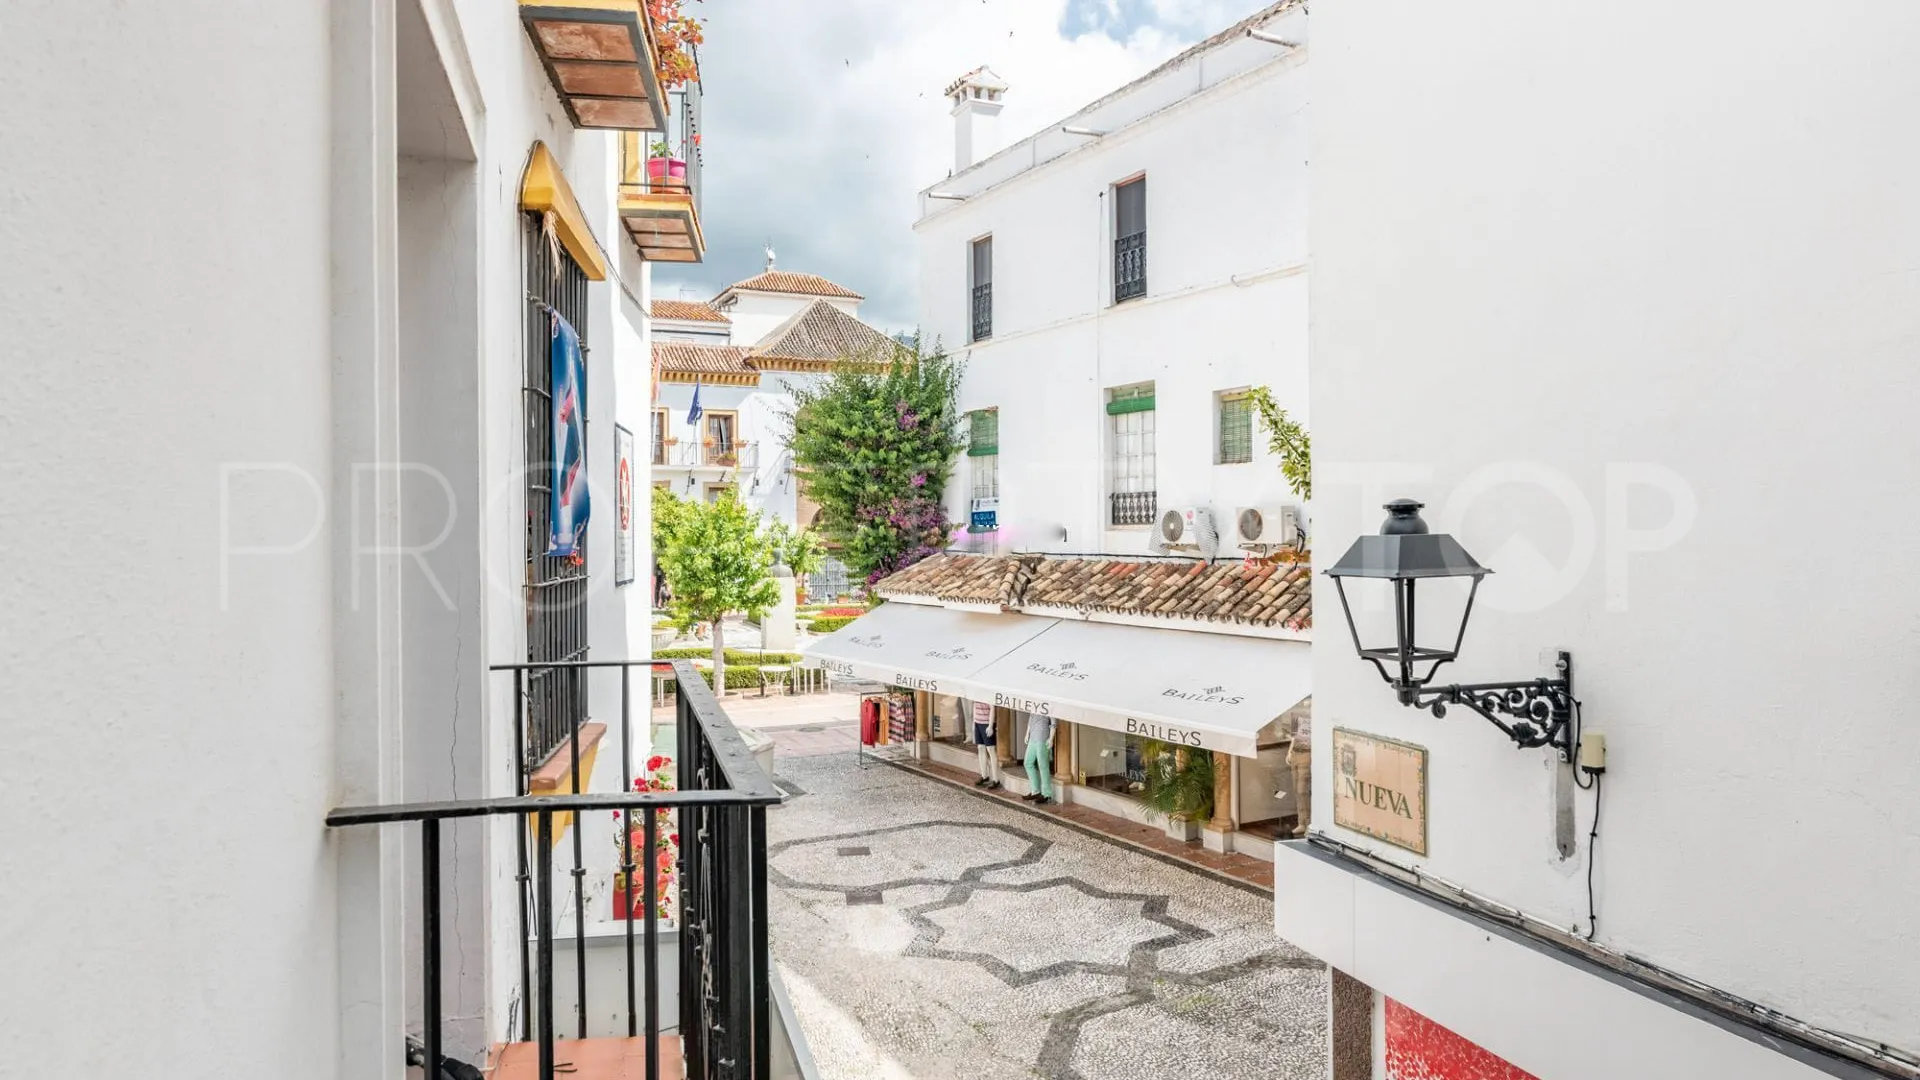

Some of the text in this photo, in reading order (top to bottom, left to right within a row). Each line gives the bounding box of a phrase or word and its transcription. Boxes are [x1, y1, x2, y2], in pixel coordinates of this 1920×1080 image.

[925, 649, 973, 660] BAILEYS
[820, 659, 854, 675] BAILEYS
[1026, 662, 1089, 681] BAILEYS
[895, 673, 938, 691] BAILEYS
[994, 692, 1050, 715] BAILEYS
[1162, 688, 1245, 705] BAILEYS
[1126, 718, 1202, 746] BAILEYS
[1344, 777, 1413, 820] NUEVA
